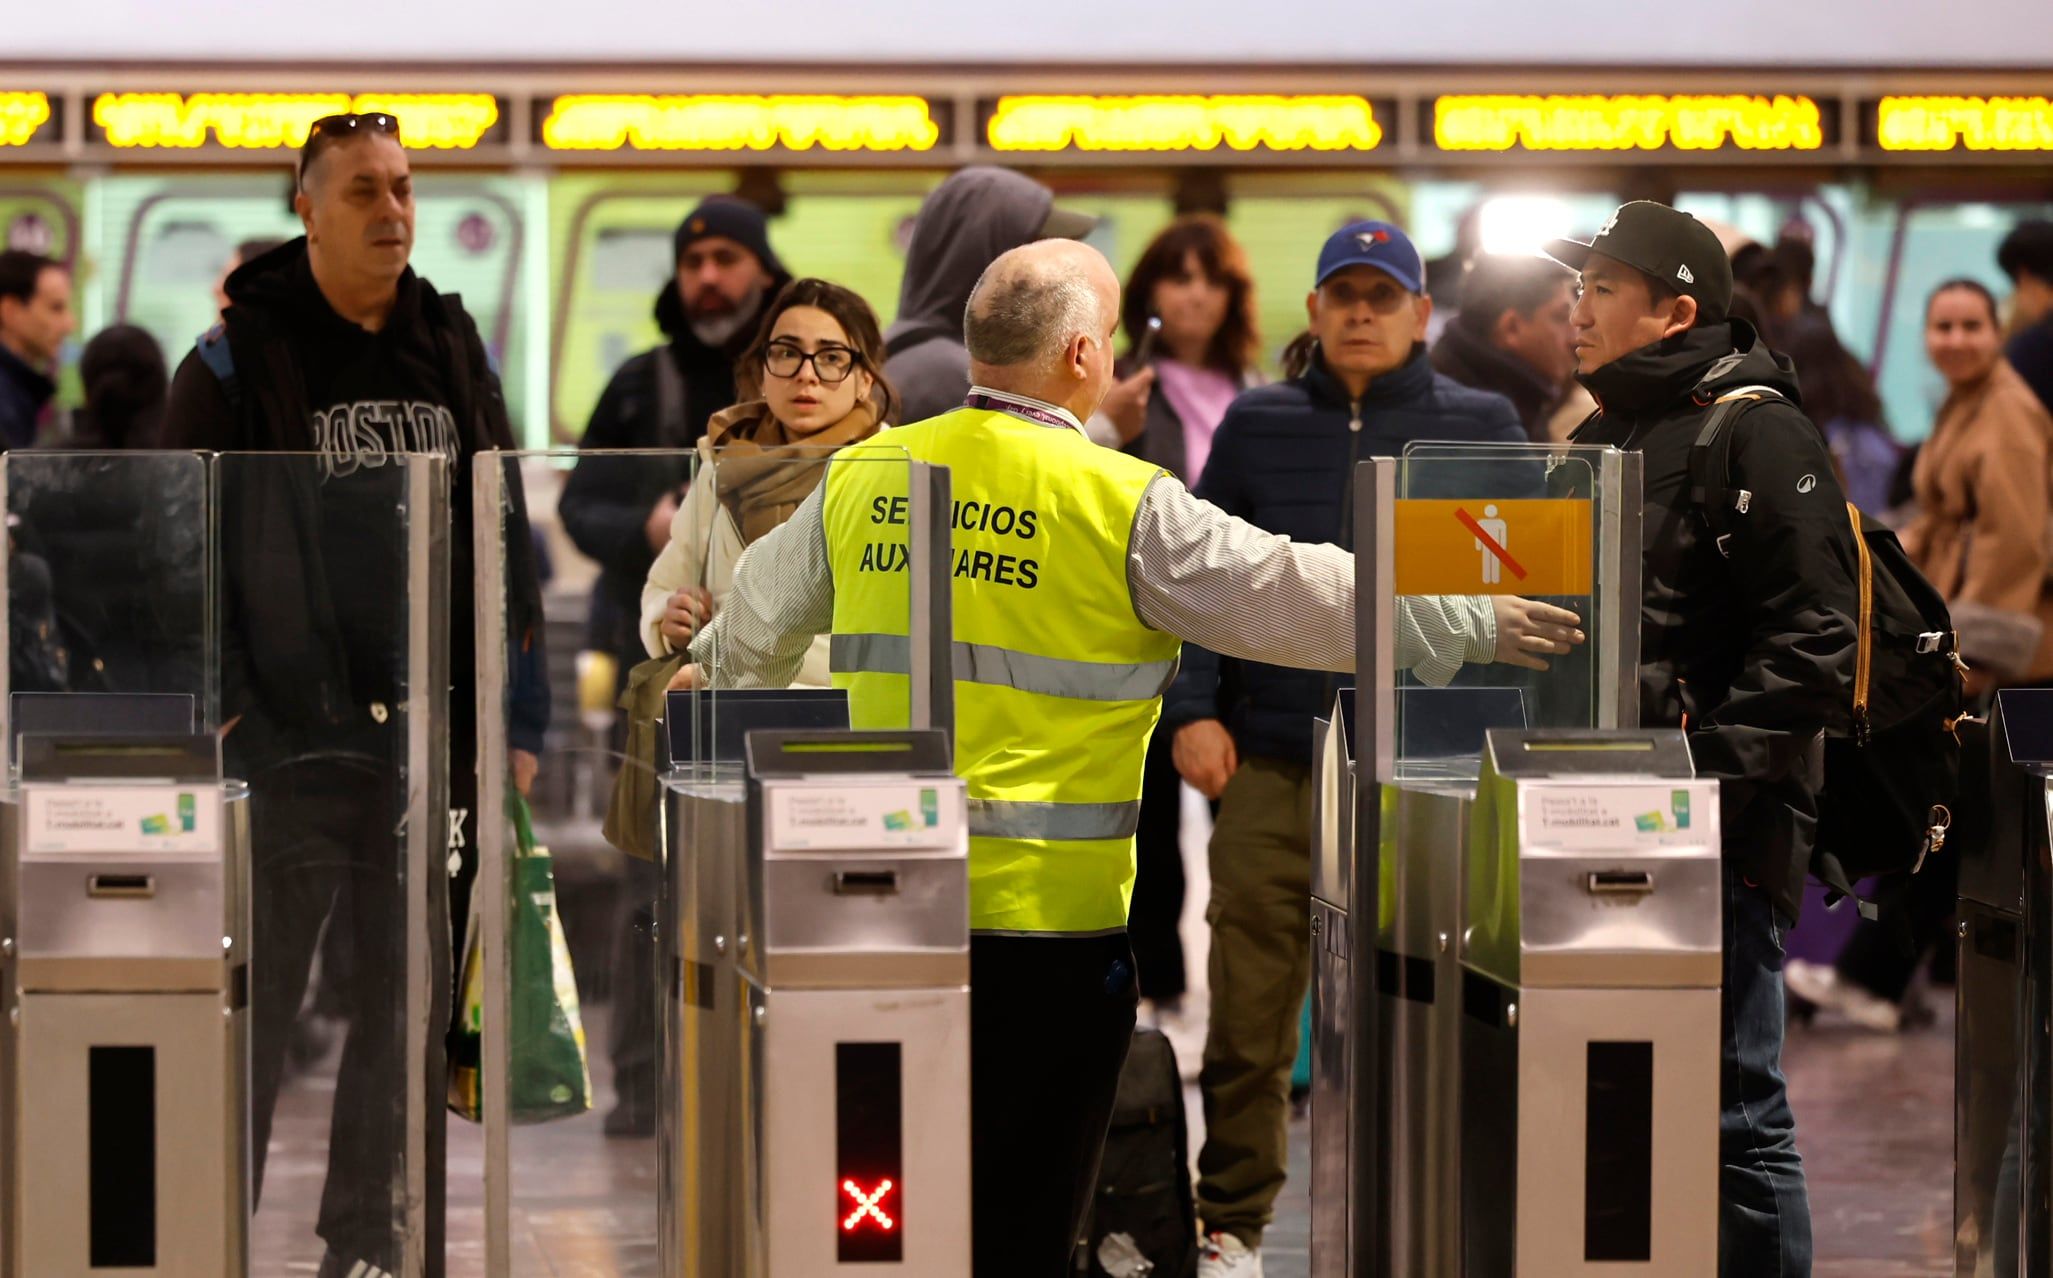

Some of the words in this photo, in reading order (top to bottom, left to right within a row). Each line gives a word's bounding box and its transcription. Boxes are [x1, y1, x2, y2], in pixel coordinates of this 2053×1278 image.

[871, 495, 1037, 540] SEICIOS
[859, 543, 1039, 589] AUXARES
[448, 808, 468, 848] K
